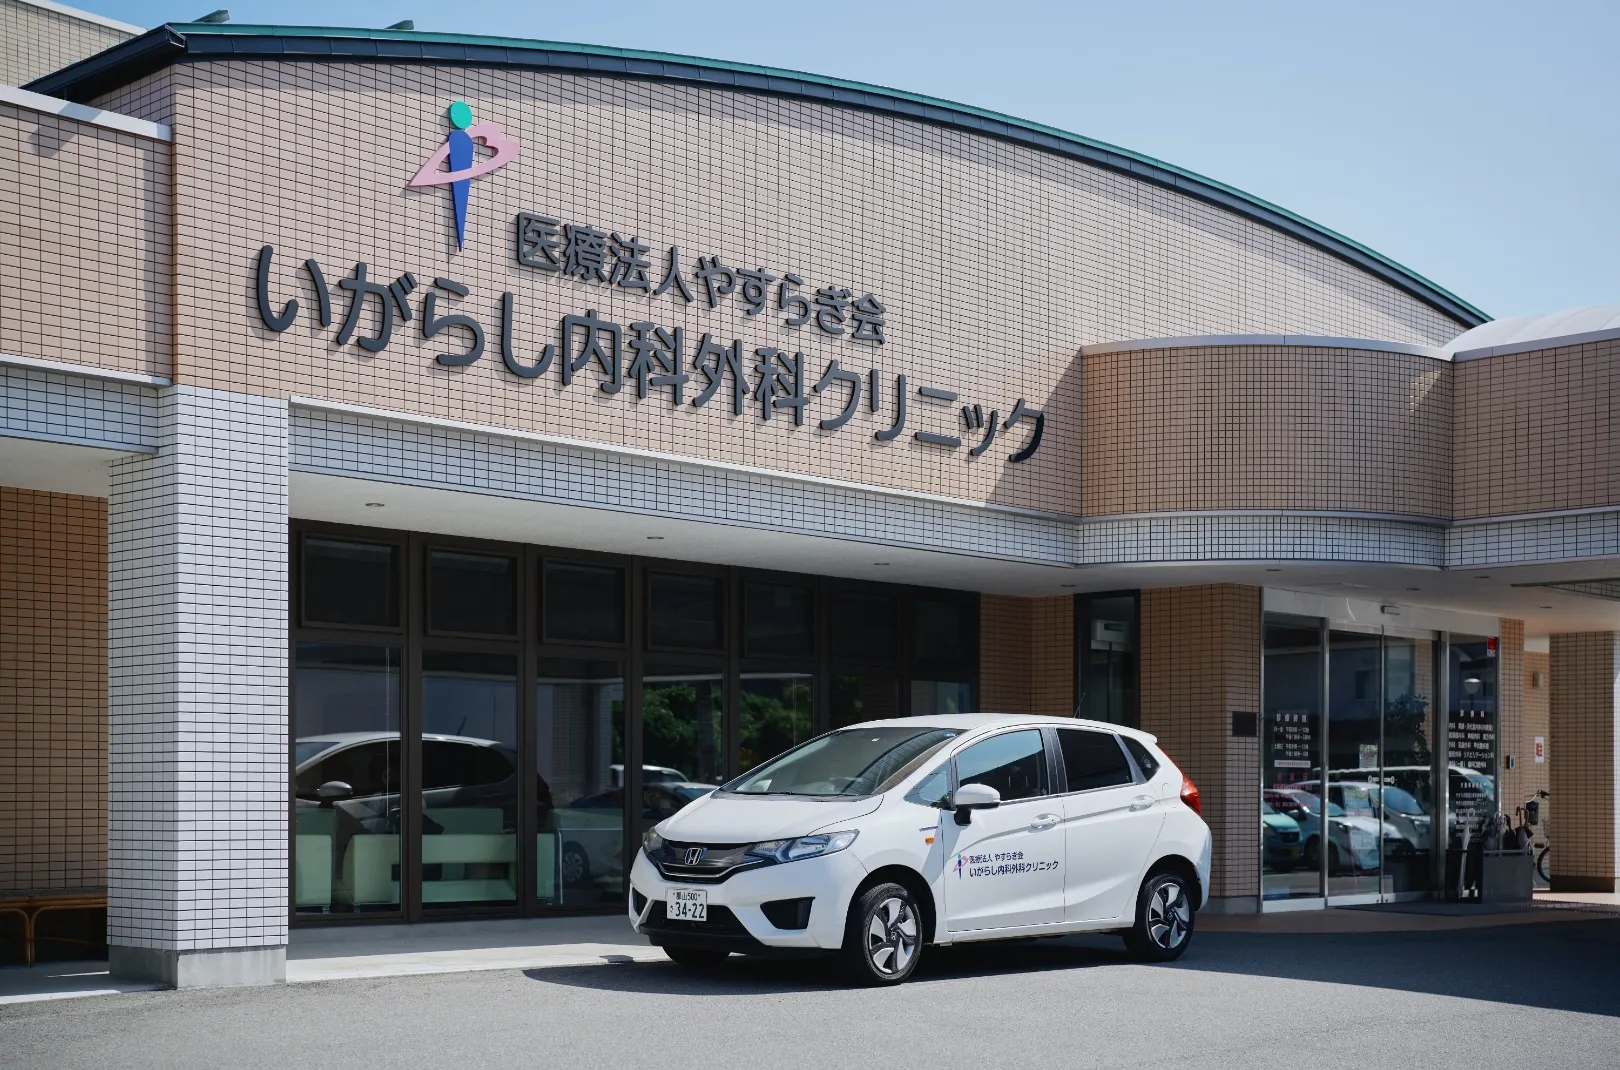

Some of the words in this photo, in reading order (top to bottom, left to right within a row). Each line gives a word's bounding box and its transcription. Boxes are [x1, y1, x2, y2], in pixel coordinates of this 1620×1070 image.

[516, 211, 887, 345] 医療法人やすらぎ会
[256, 244, 1045, 463] いがらし内科外科クリニック
[994, 851, 1024, 861] やすらぎ会
[969, 860, 1059, 878] いがらし内科外科クリニック
[675, 901, 705, 919] 34-22
